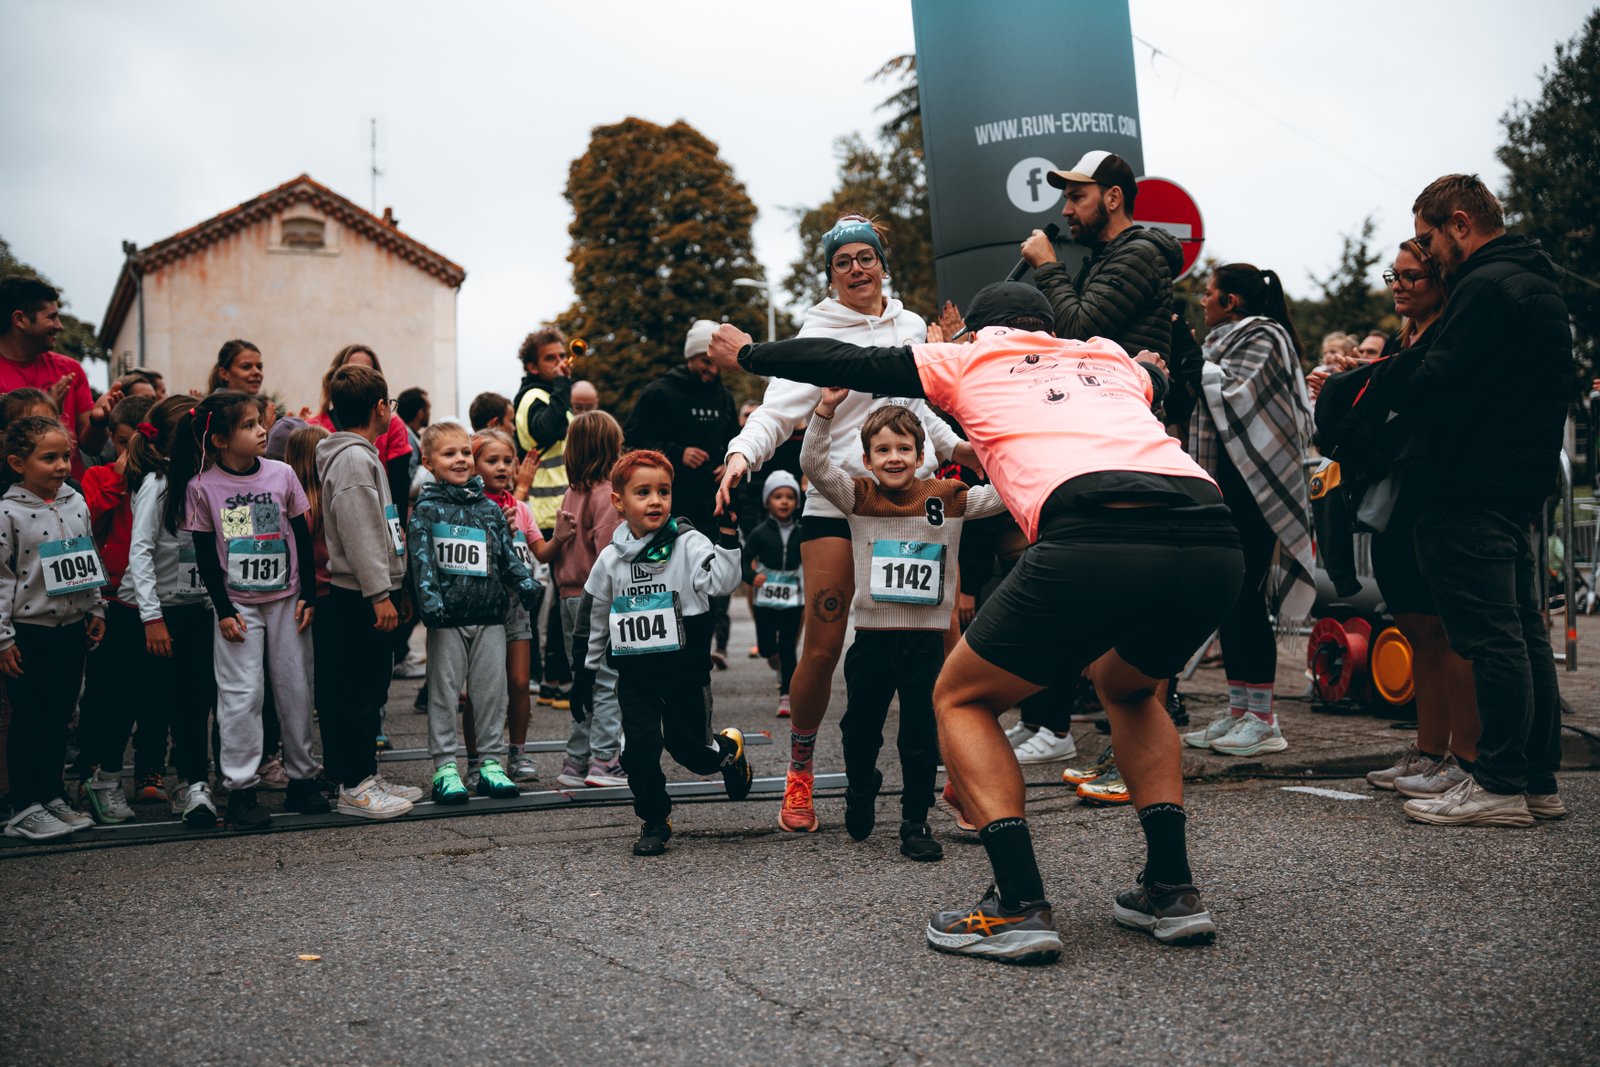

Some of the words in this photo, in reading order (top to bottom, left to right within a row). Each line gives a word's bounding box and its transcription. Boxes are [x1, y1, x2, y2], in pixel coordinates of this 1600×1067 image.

[436, 542, 480, 565] 1106
[49, 554, 97, 583] 1094
[239, 558, 279, 580] 1131
[882, 562, 932, 590] 1142
[765, 585, 790, 600] 548
[617, 614, 667, 643] 1104
